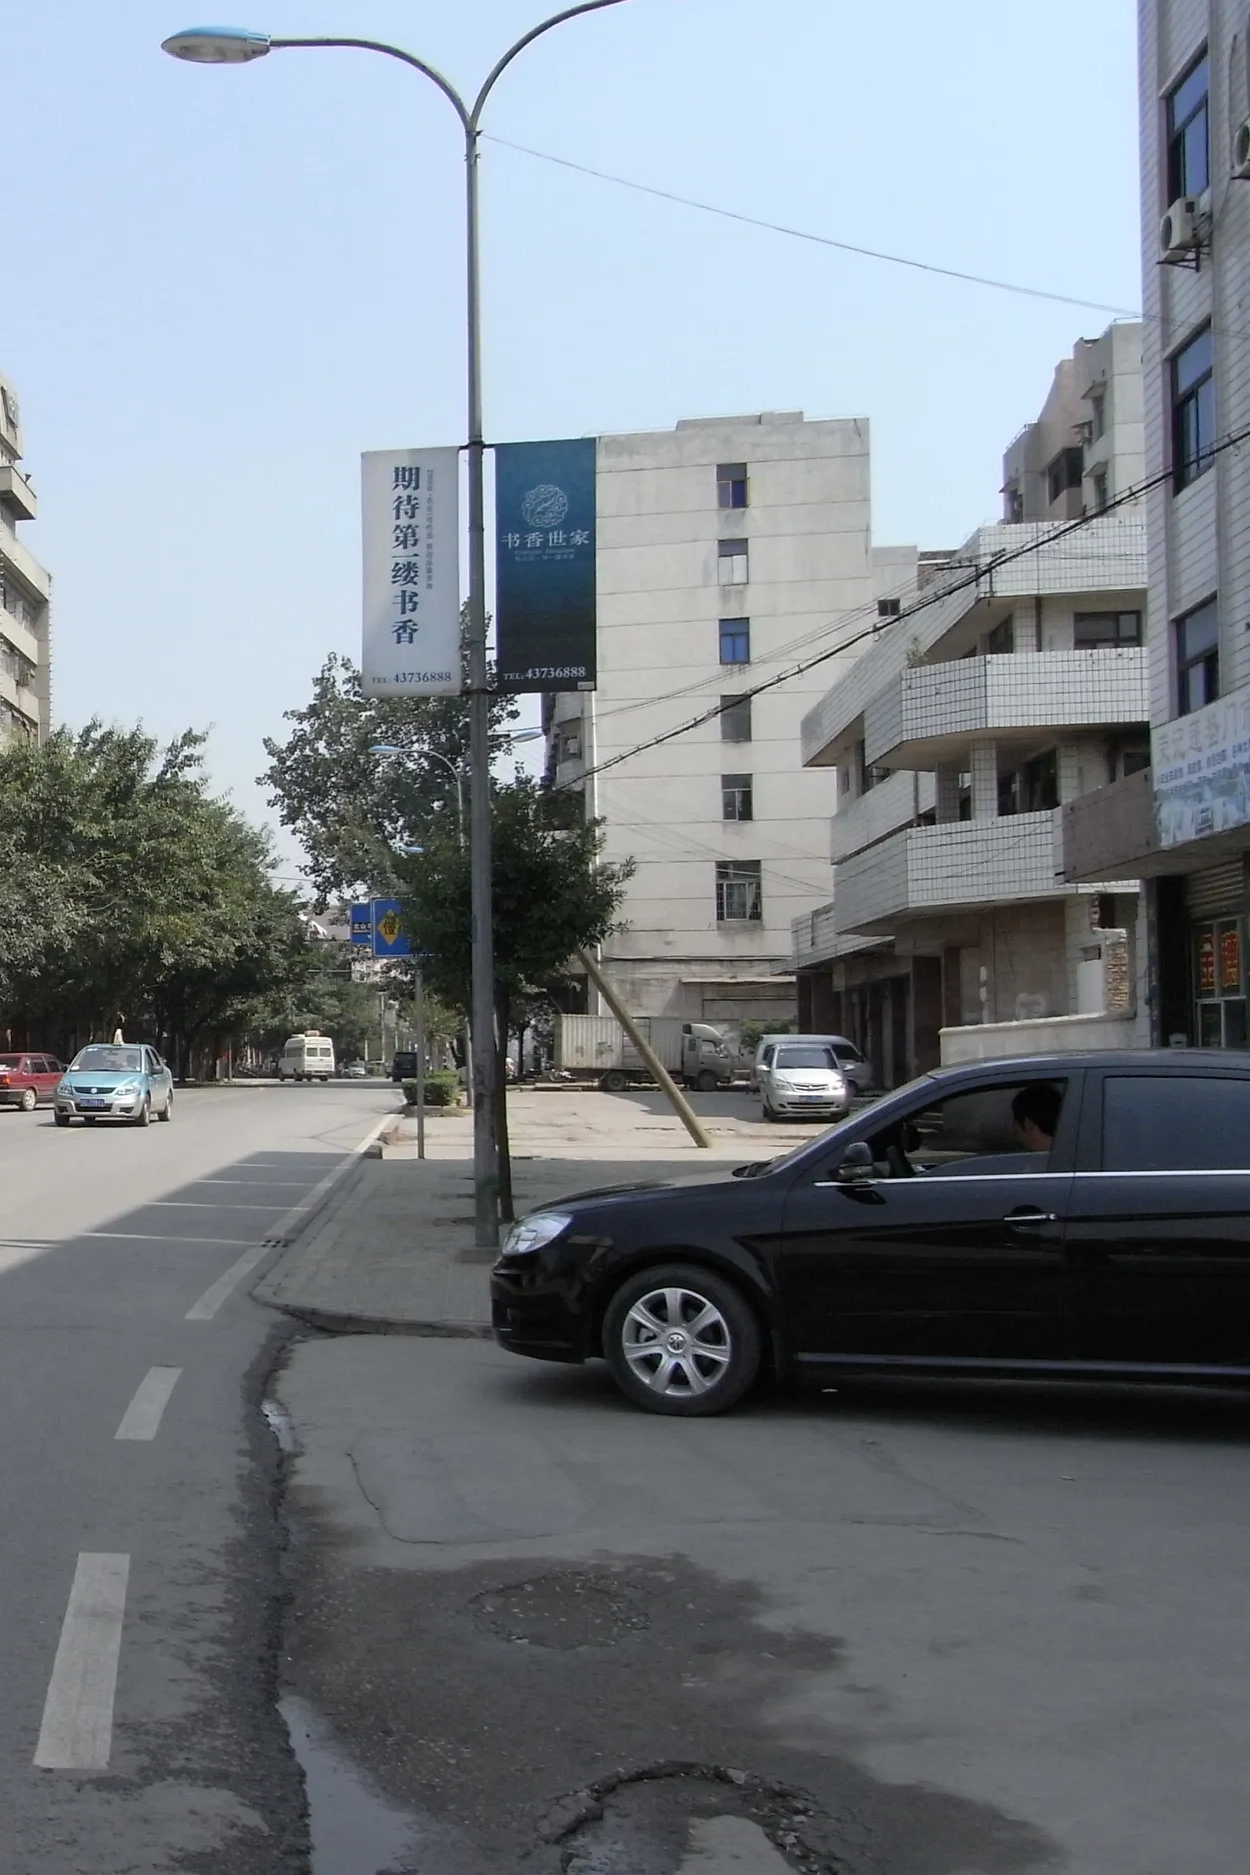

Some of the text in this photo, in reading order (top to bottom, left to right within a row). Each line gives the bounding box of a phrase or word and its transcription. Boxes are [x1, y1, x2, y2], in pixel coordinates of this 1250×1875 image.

[391, 466, 420, 644] 期待第一缕书香
[502, 529, 590, 548] 书香世家
